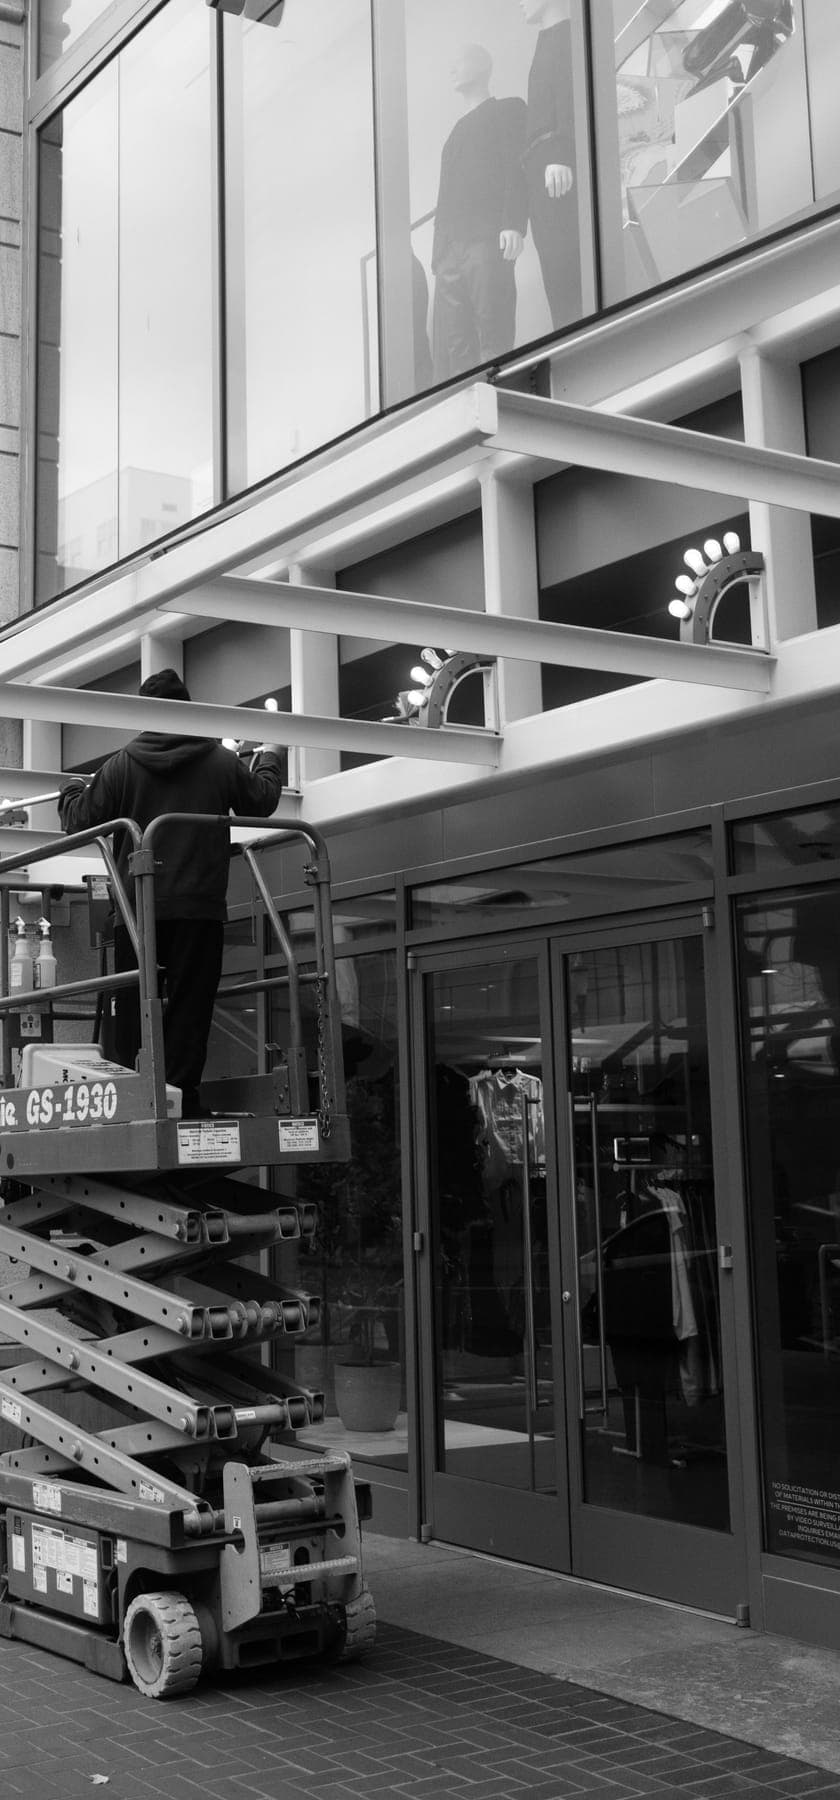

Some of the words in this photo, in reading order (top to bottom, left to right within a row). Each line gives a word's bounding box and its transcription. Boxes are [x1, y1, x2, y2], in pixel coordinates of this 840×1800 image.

[26, 1082, 117, 1125] GS-1930
[781, 1484, 818, 1496] SOLICITATION
[783, 1493, 813, 1504] MATERIALS
[814, 1499, 833, 1508] WITHIN
[770, 1502, 781, 1510] THE
[781, 1505, 807, 1515] PREMISES
[808, 1510, 819, 1518] ARE
[820, 1512, 837, 1521] BEING
[795, 1516, 812, 1525] VIDEO
[798, 1525, 824, 1536] INQUIRIES
